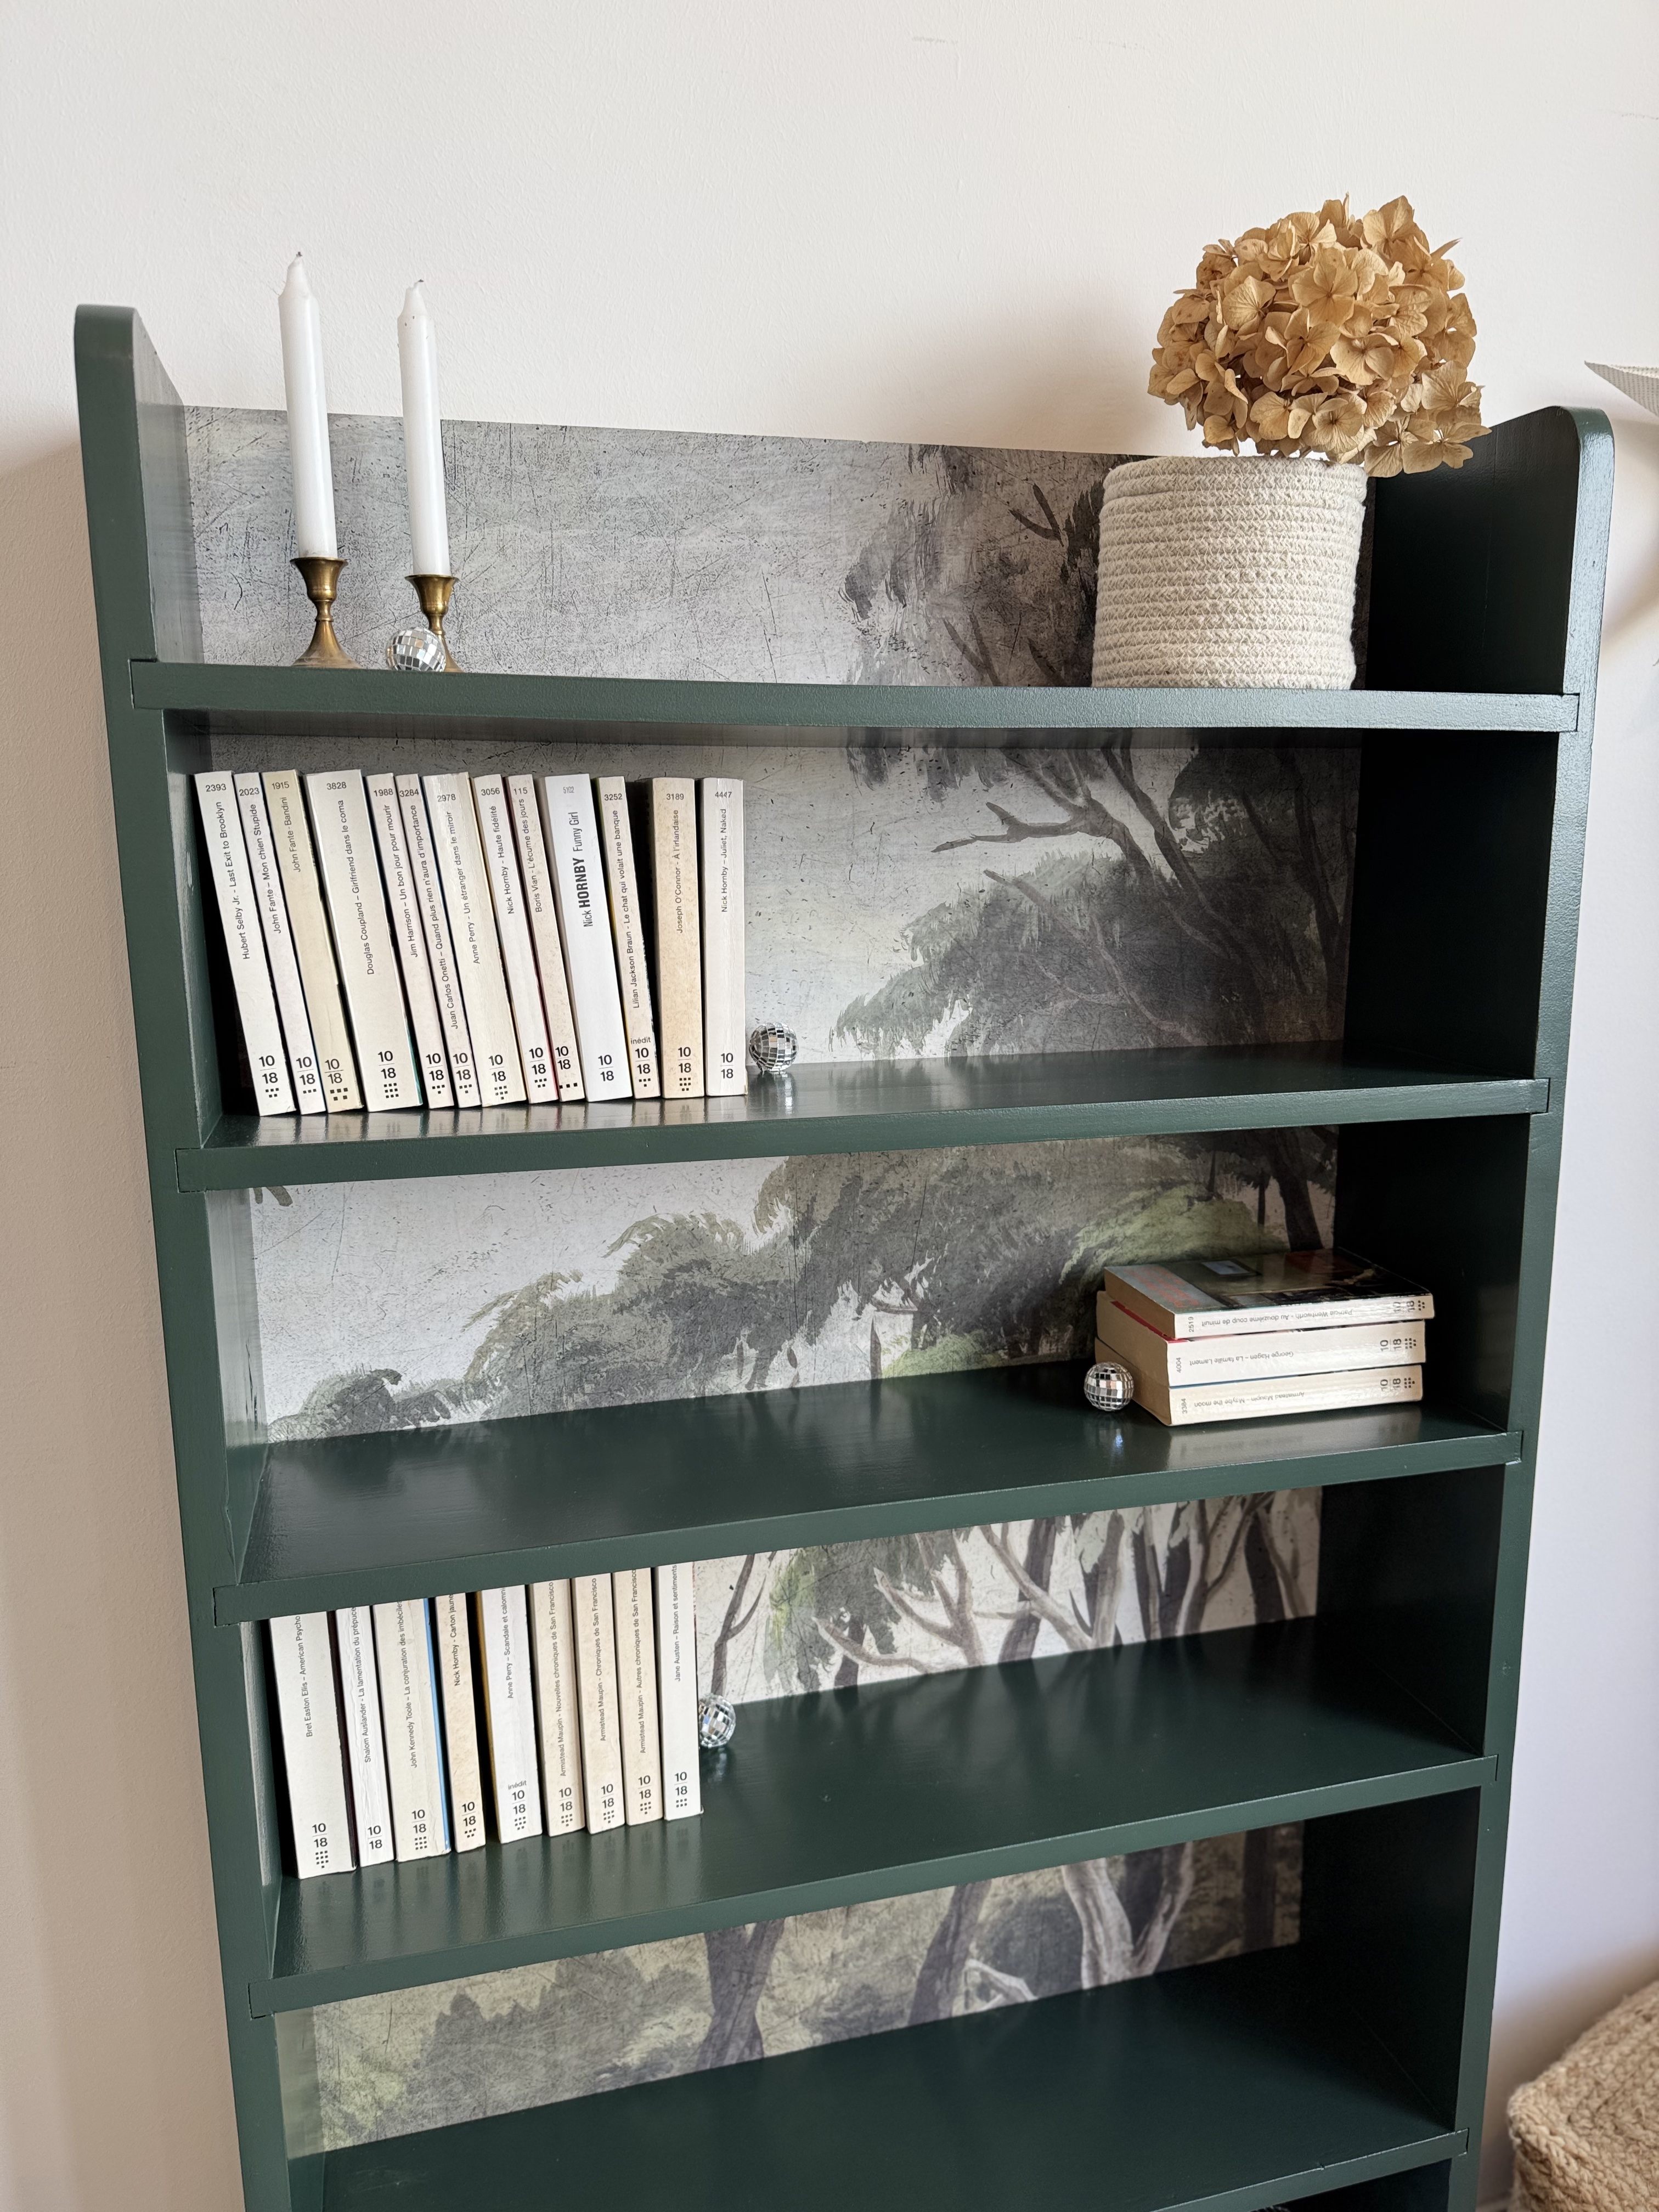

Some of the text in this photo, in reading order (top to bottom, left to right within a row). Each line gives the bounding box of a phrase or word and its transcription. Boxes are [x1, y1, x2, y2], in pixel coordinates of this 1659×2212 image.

[205, 783, 227, 792] 2393
[239, 787, 260, 797] 2023
[272, 781, 290, 791] 1915
[326, 781, 347, 791] 3828
[373, 788, 394, 797] 1988
[399, 788, 420, 798] 3284
[481, 787, 500, 796] 3056
[513, 787, 528, 795] 115
[563, 786, 575, 794] 5102
[437, 794, 456, 803] 2978
[337, 800, 347, 823] coma
[384, 804, 394, 831] mourir
[518, 799, 529, 819] jours
[612, 810, 620, 840] banque
[280, 797, 301, 872] John Fante Bandini
[389, 833, 400, 851] pour
[344, 834, 353, 855] dans
[250, 804, 281, 934] John Fante Mon chien Stupide
[393, 853, 403, 870] jour
[489, 806, 515, 915] Nick Hornby Haute fidélité
[568, 811, 593, 927] Nick HORNBY Funny Girl
[617, 858, 625, 879] volait
[216, 802, 250, 960] Hubert Selby Jr. Last Exit to Brooklyn
[346, 856, 360, 894] Girlfriend
[397, 871, 405, 887] bon
[399, 888, 407, 900] Un
[446, 811, 481, 964] Anne Perry Un étranger dans le miroir
[619, 881, 628, 893] qui
[533, 893, 543, 913] Boris
[354, 902, 368, 941] Coupland
[430, 904, 439, 922] plus
[623, 914, 630, 924] Le
[675, 906, 684, 934] Joseph
[404, 909, 415, 942] Harrison
[431, 923, 443, 950] Quand
[363, 942, 375, 975] Douglas
[438, 958, 449, 982] Onetti
[629, 956, 637, 987] Jackson
[444, 983, 454, 1009] Carlos
[450, 1011, 458, 1029] Juan
[631, 1036, 651, 1045] inédit
[258, 1055, 275, 1067] 10
[598, 1054, 612, 1065] 10
[720, 1053, 734, 1063] 10
[262, 1072, 278, 1085] 18
[600, 1070, 614, 1082] 18
[721, 1069, 733, 1079] 18
[1380, 1339, 1389, 1352] 10
[1393, 1338, 1402, 1351] 18
[1189, 1358, 1213, 1367] Lament
[448, 1594, 456, 1613] jaune
[547, 1582, 556, 1615] Francisco
[294, 1616, 304, 1641] Psycho
[351, 1607, 360, 1635] prépuce
[502, 1624, 511, 1656] Scandale
[550, 1631, 557, 1640] de
[593, 1627, 600, 1637] de
[353, 1637, 360, 1646] du
[298, 1642, 307, 1675] American
[452, 1644, 460, 1669] Hornby
[354, 1647, 364, 1688] lamentation
[400, 1647, 410, 1685] conjuration
[301, 1681, 309, 1696] Ellis
[358, 1688, 365, 1697] La
[404, 1686, 410, 1695] La
[554, 1679, 562, 1713] Nouvelles
[359, 1703, 369, 1736] Auslander
[405, 1702, 413, 1720] Toole
[556, 1718, 565, 1743] Maupin
[598, 1708, 606, 1741] Armistead
[407, 1722, 416, 1751] Kennedy
[558, 1743, 566, 1776] Armistead
[507, 1780, 527, 1790] inédit
[674, 1771, 687, 1782] 10
[675, 1786, 687, 1796] 18
[312, 1823, 326, 1834] 10
[313, 1837, 328, 1848] 18
